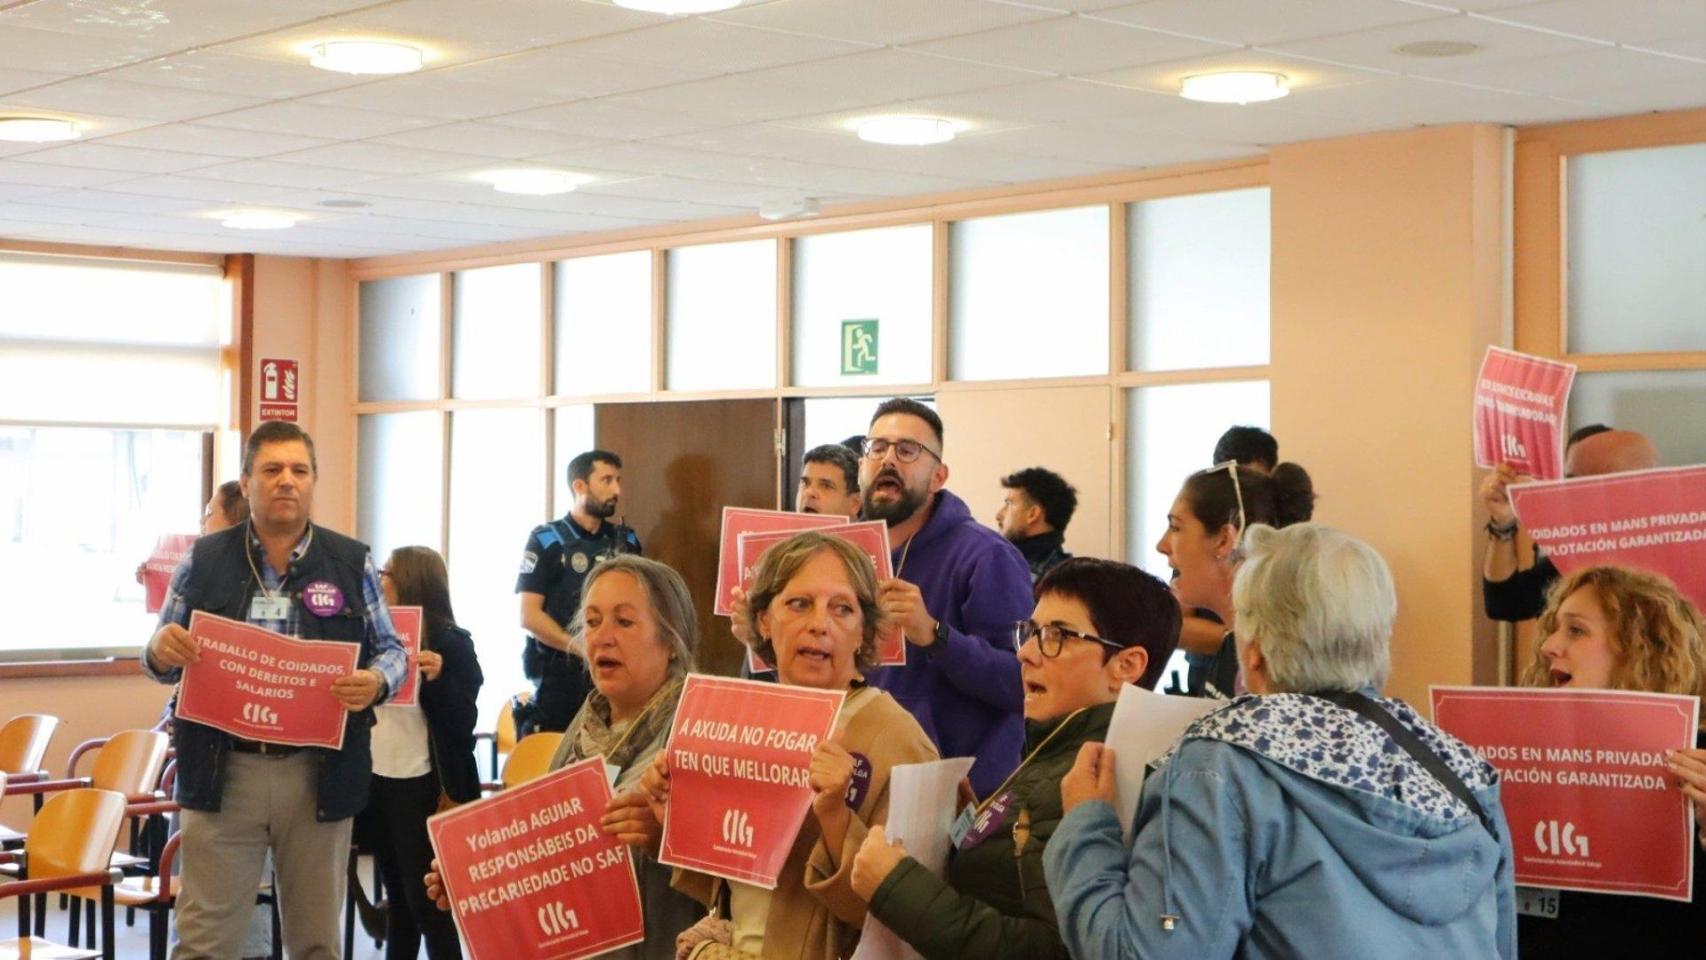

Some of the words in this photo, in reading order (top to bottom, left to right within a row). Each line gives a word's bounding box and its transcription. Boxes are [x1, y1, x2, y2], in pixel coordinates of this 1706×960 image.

[261, 408, 295, 417] EXTINTOR
[1528, 525, 1587, 540] OIDADOS
[1590, 522, 1608, 535] EN
[1610, 518, 1649, 533] MANS
[197, 635, 258, 662] TRABALLO
[259, 655, 276, 667] DE
[219, 659, 246, 675] CON
[248, 667, 307, 687] DEREITOS
[309, 678, 317, 687] E
[235, 680, 295, 700] SALARIOS
[242, 702, 279, 725] CIG
[678, 718, 690, 736] A
[689, 719, 737, 743] AXUDA
[738, 725, 765, 746] NO
[764, 728, 818, 753] FOGAR
[674, 749, 699, 772] TEN
[702, 754, 730, 778] QUE
[733, 759, 810, 788] MELLORAR
[1471, 745, 1518, 760] ADOS
[1521, 747, 1543, 761] EN
[1546, 748, 1593, 764] MANS
[1596, 750, 1668, 768] PRIVADA
[1556, 770, 1667, 791] GARANTIZADA
[466, 817, 529, 853] Yolanda
[530, 796, 585, 831] AGUIAR
[722, 808, 754, 848] CIG
[1534, 820, 1590, 858] CIG
[468, 833, 576, 883] RESPONSÁBEIS
[575, 823, 599, 845] DA
[458, 865, 570, 917] PRECARIEDADE
[570, 858, 594, 879] NO
[595, 845, 626, 870] SAF
[537, 900, 580, 937] CIG
[1538, 897, 1556, 915] 15
